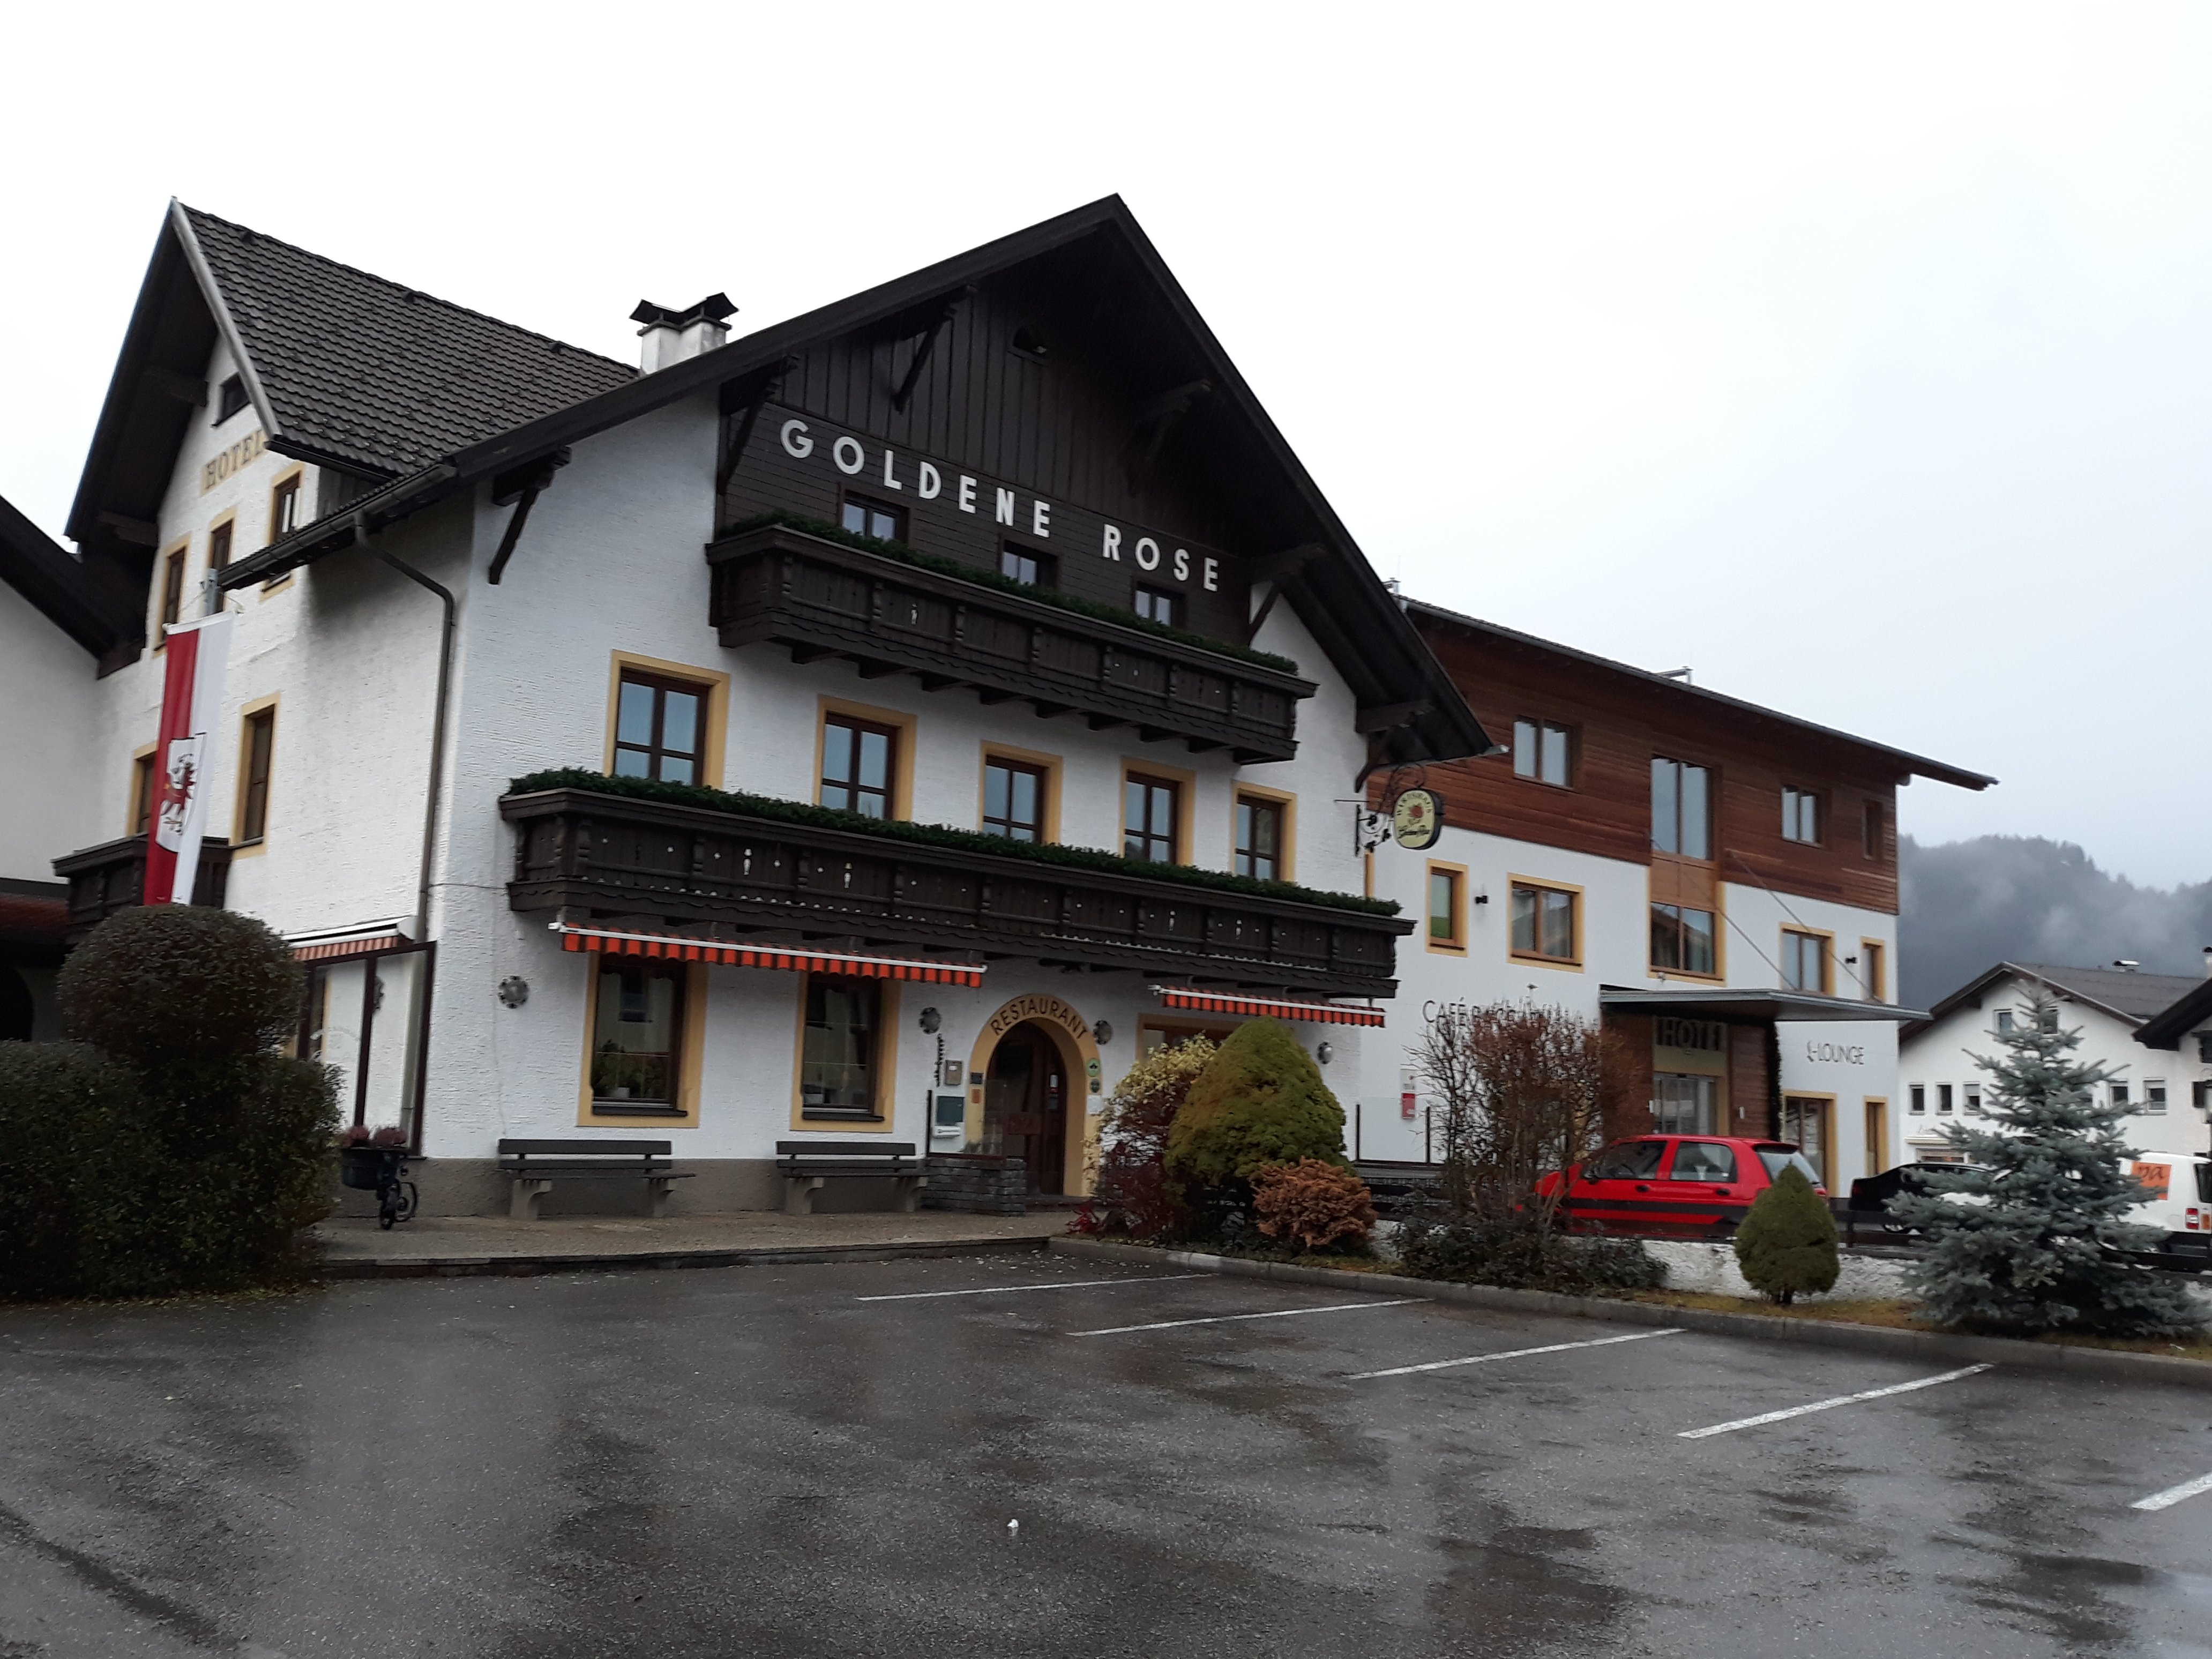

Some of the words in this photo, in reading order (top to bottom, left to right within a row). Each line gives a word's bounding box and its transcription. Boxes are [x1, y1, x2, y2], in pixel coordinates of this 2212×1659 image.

[205, 428, 264, 490] HOTEL
[780, 419, 1051, 537] GOLDENE
[1101, 523, 1220, 592] ROSE
[991, 998, 1088, 1040] RESTAURANT
[1423, 997, 1466, 1026] CAFÉ
